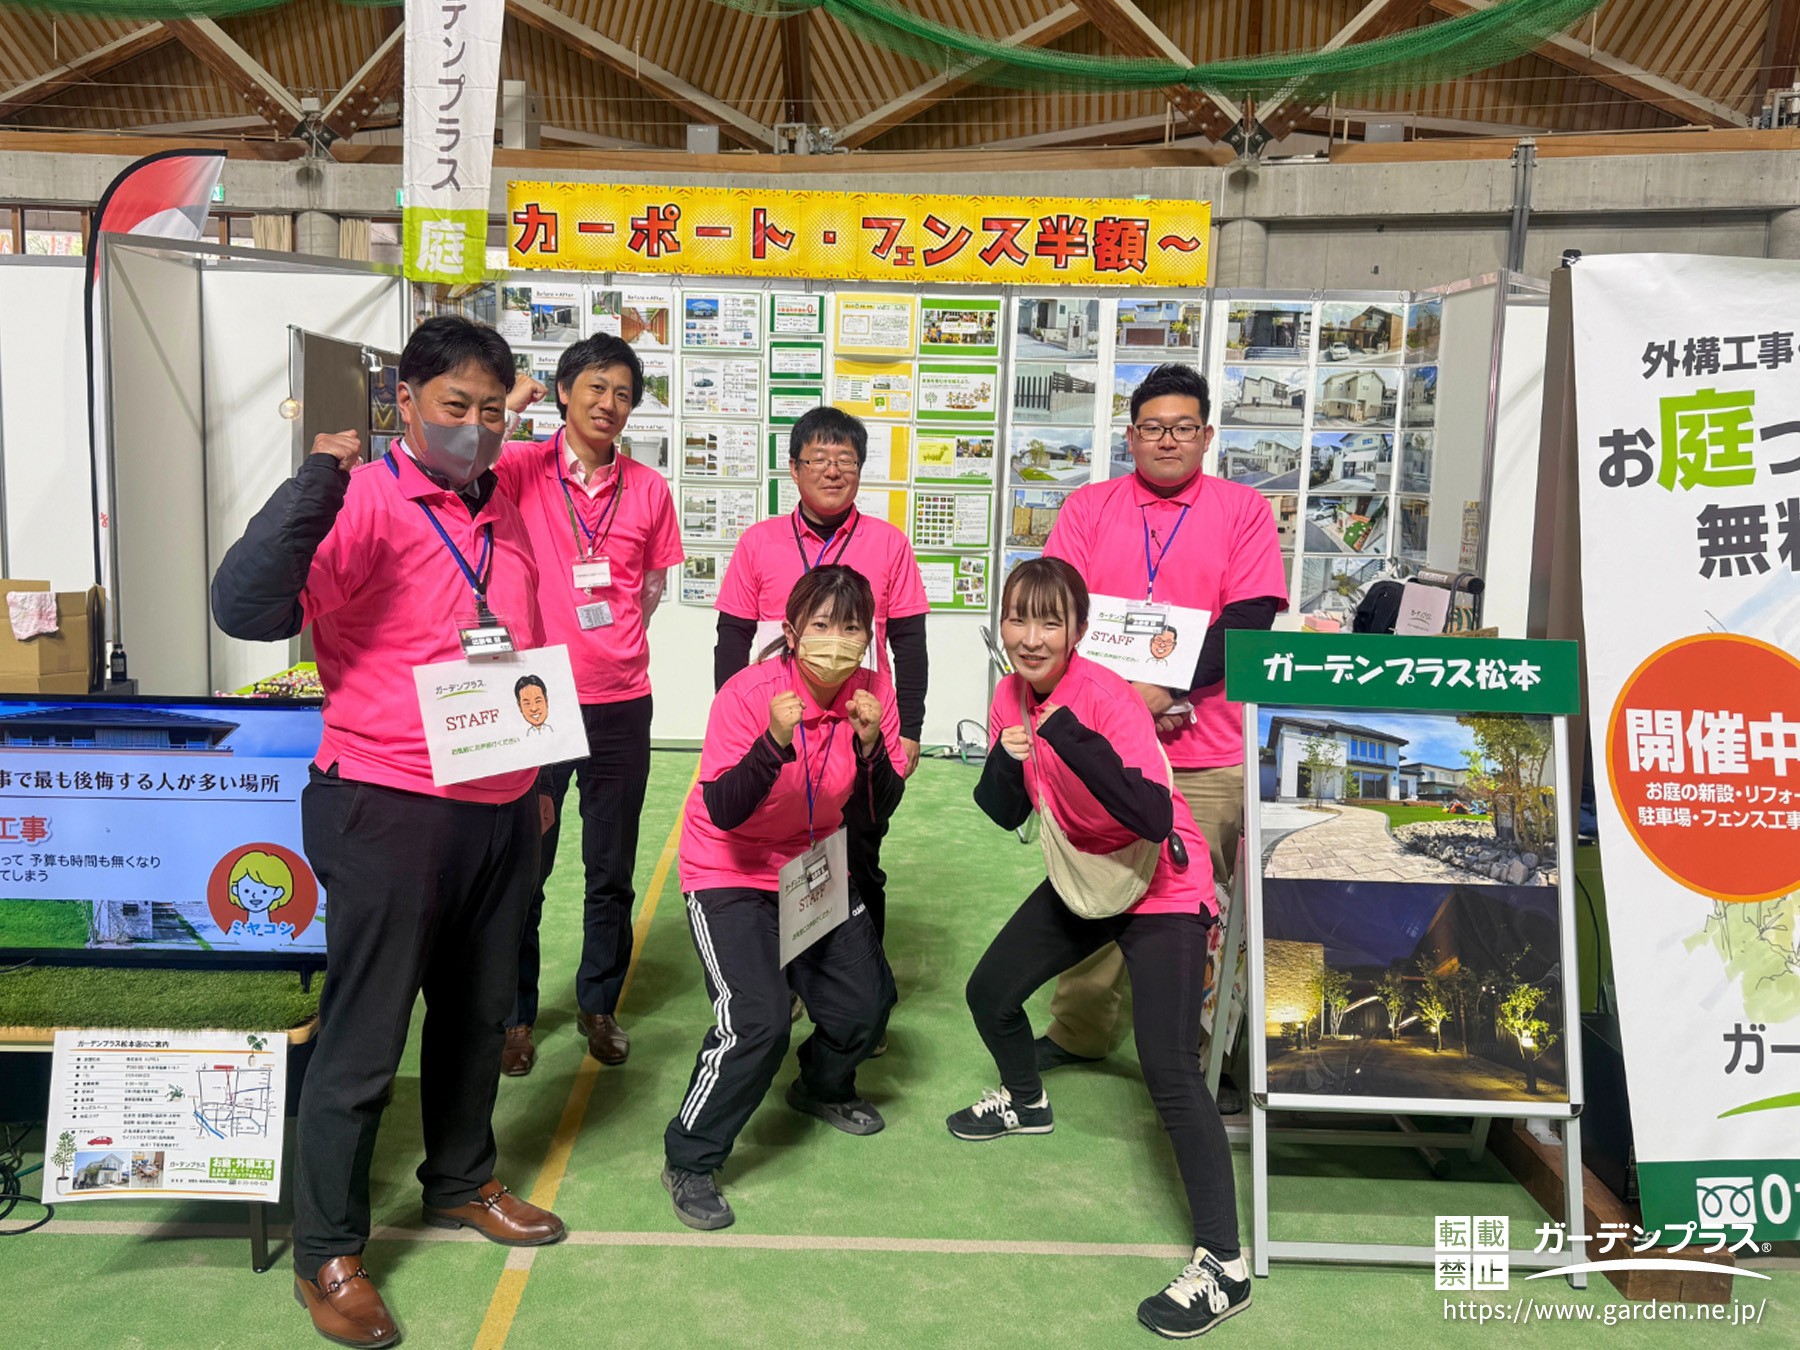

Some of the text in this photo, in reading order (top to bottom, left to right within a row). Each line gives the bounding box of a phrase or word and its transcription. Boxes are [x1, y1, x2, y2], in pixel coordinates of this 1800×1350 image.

[415, 218, 466, 275] 庭
[1090, 630, 1135, 646] STAFF
[1262, 652, 1542, 692] ガーデンプラス松本
[445, 708, 500, 732] STAFF
[1625, 707, 1800, 778] 開催中
[29, 853, 161, 869] 予算も時間も無くなり
[231, 921, 295, 937] ミヤコシ
